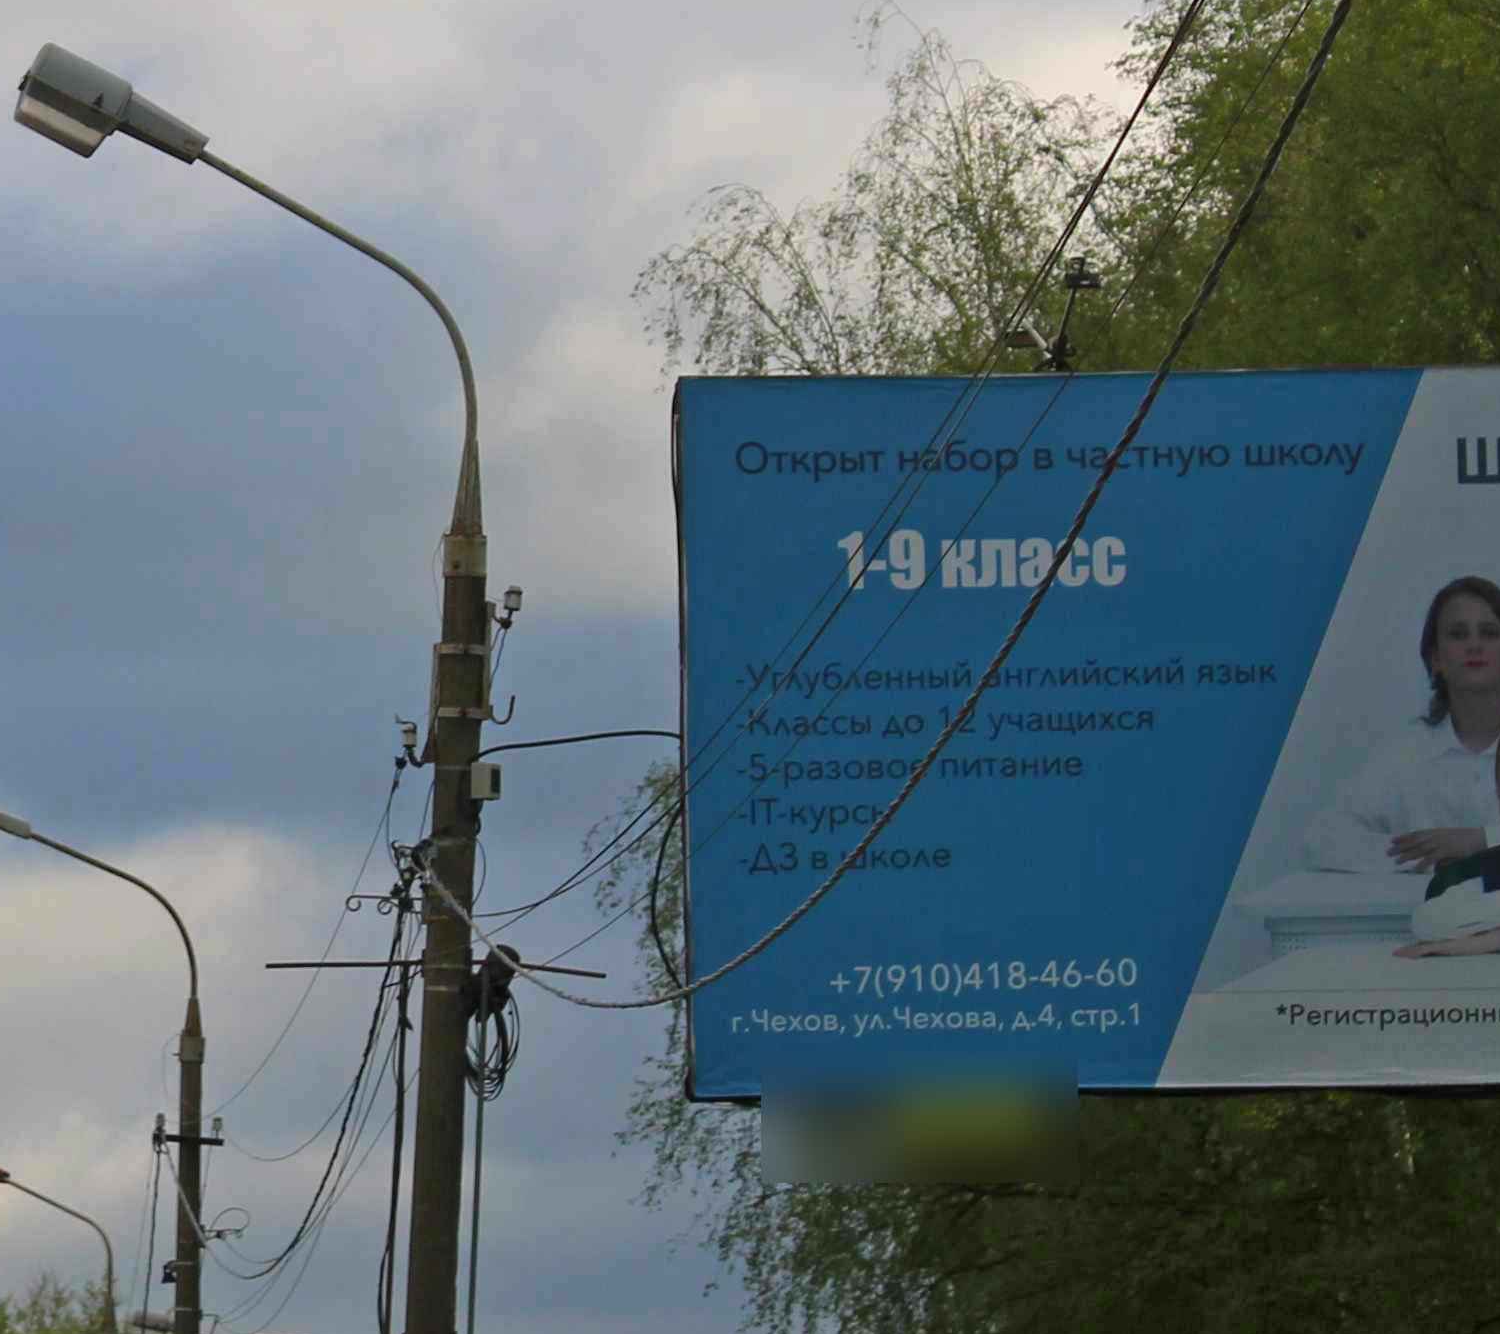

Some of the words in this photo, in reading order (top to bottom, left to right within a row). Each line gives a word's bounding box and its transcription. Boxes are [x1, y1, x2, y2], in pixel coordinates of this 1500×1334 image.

[736, 441, 886, 483] Открыт
[900, 440, 1018, 480] набор
[1033, 447, 1053, 470] в
[1245, 442, 1365, 475] школу
[837, 529, 926, 590] 1-9
[941, 536, 1126, 589] класс
[736, 660, 972, 699] -Углубленный
[985, 657, 1185, 688] английский
[1196, 663, 1277, 685] язык
[882, 714, 925, 739] до
[938, 705, 976, 734] 12
[987, 709, 1154, 741] учащихся
[941, 755, 1083, 780] питание
[811, 850, 829, 869] в
[841, 847, 952, 872] школе
[829, 958, 1138, 998] +7(910)418-46-60
[731, 1008, 846, 1035] г.Чехов,
[853, 1005, 1003, 1037] ул.Чехова,
[1011, 1003, 1063, 1031] д.4,
[1071, 1002, 1140, 1031] стр.1
